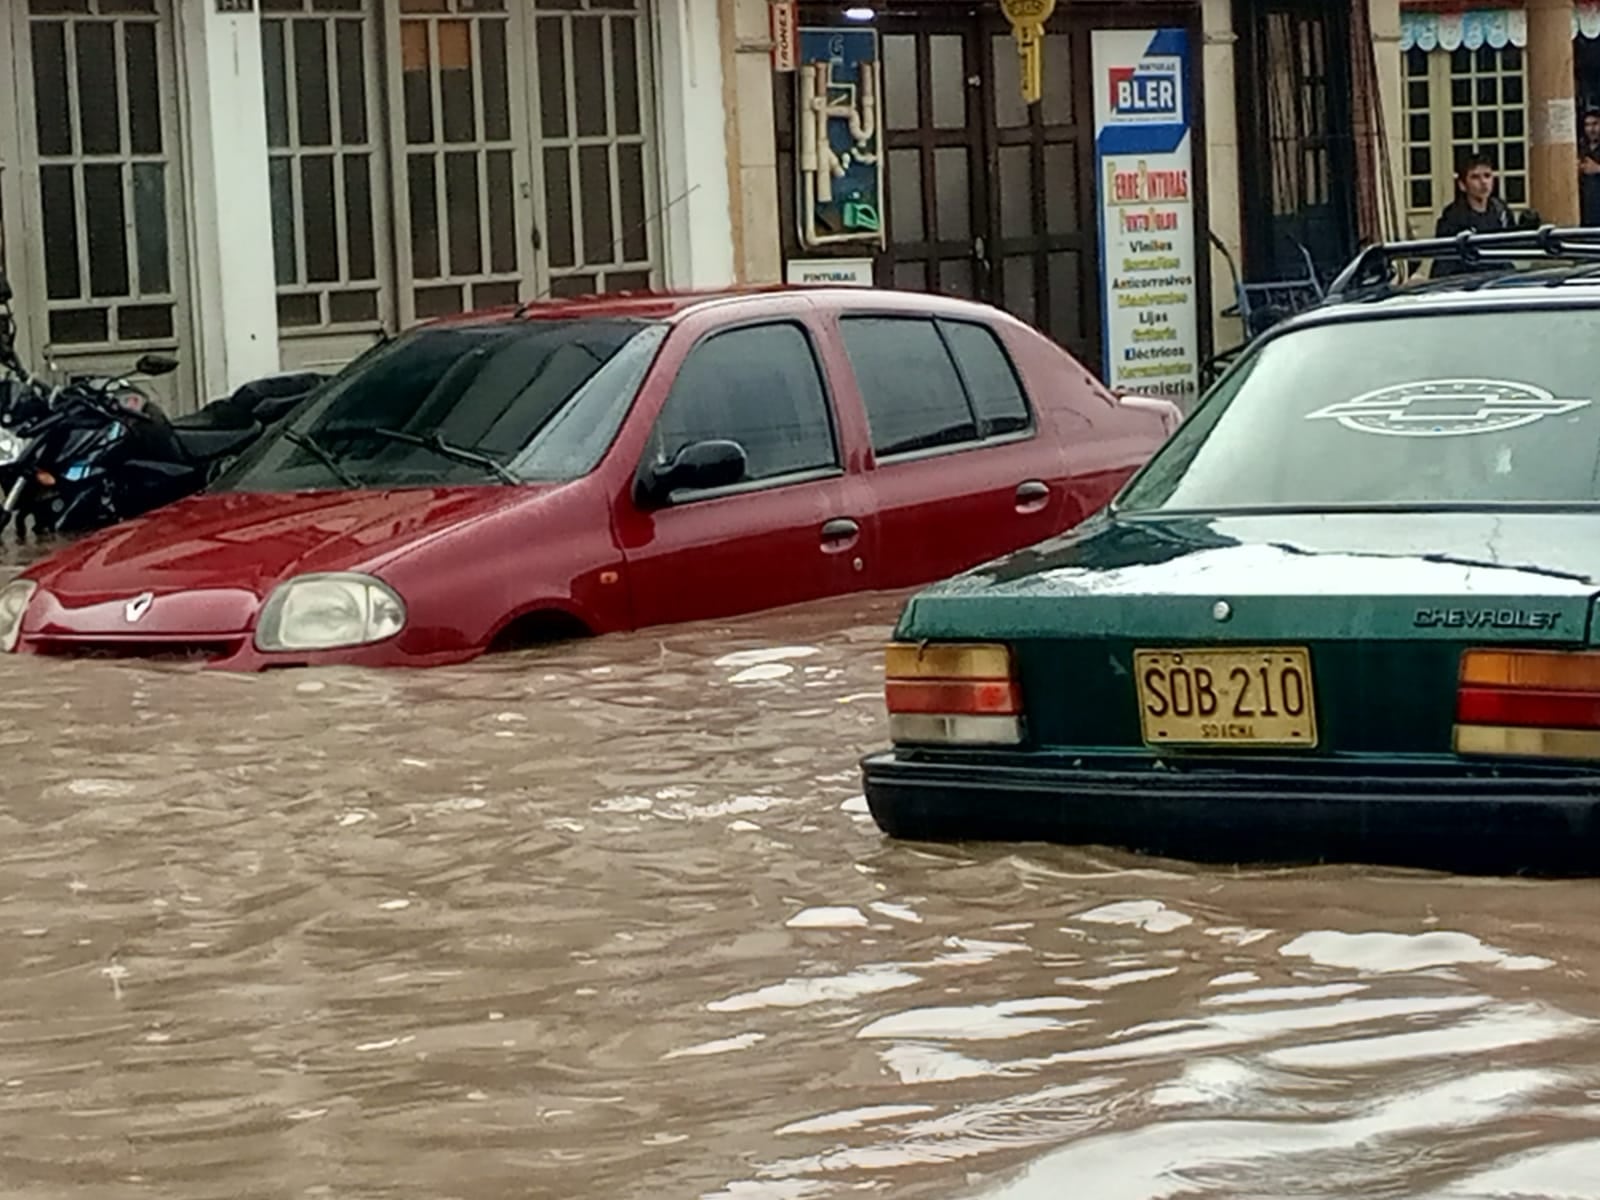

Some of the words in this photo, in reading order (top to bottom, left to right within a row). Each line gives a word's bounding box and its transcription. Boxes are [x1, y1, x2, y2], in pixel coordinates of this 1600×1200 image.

[1117, 80, 1174, 109] BLER
[1129, 240, 1173, 253] Vinilos
[803, 272, 857, 282] PINTURAS
[1112, 274, 1193, 289] Anticorrosivos
[1139, 312, 1168, 326] Lijas
[1124, 346, 1185, 361] Eléctricos
[1414, 608, 1562, 629] CHEVROLET
[1144, 667, 1218, 717] SOB
[1229, 667, 1304, 717] 210
